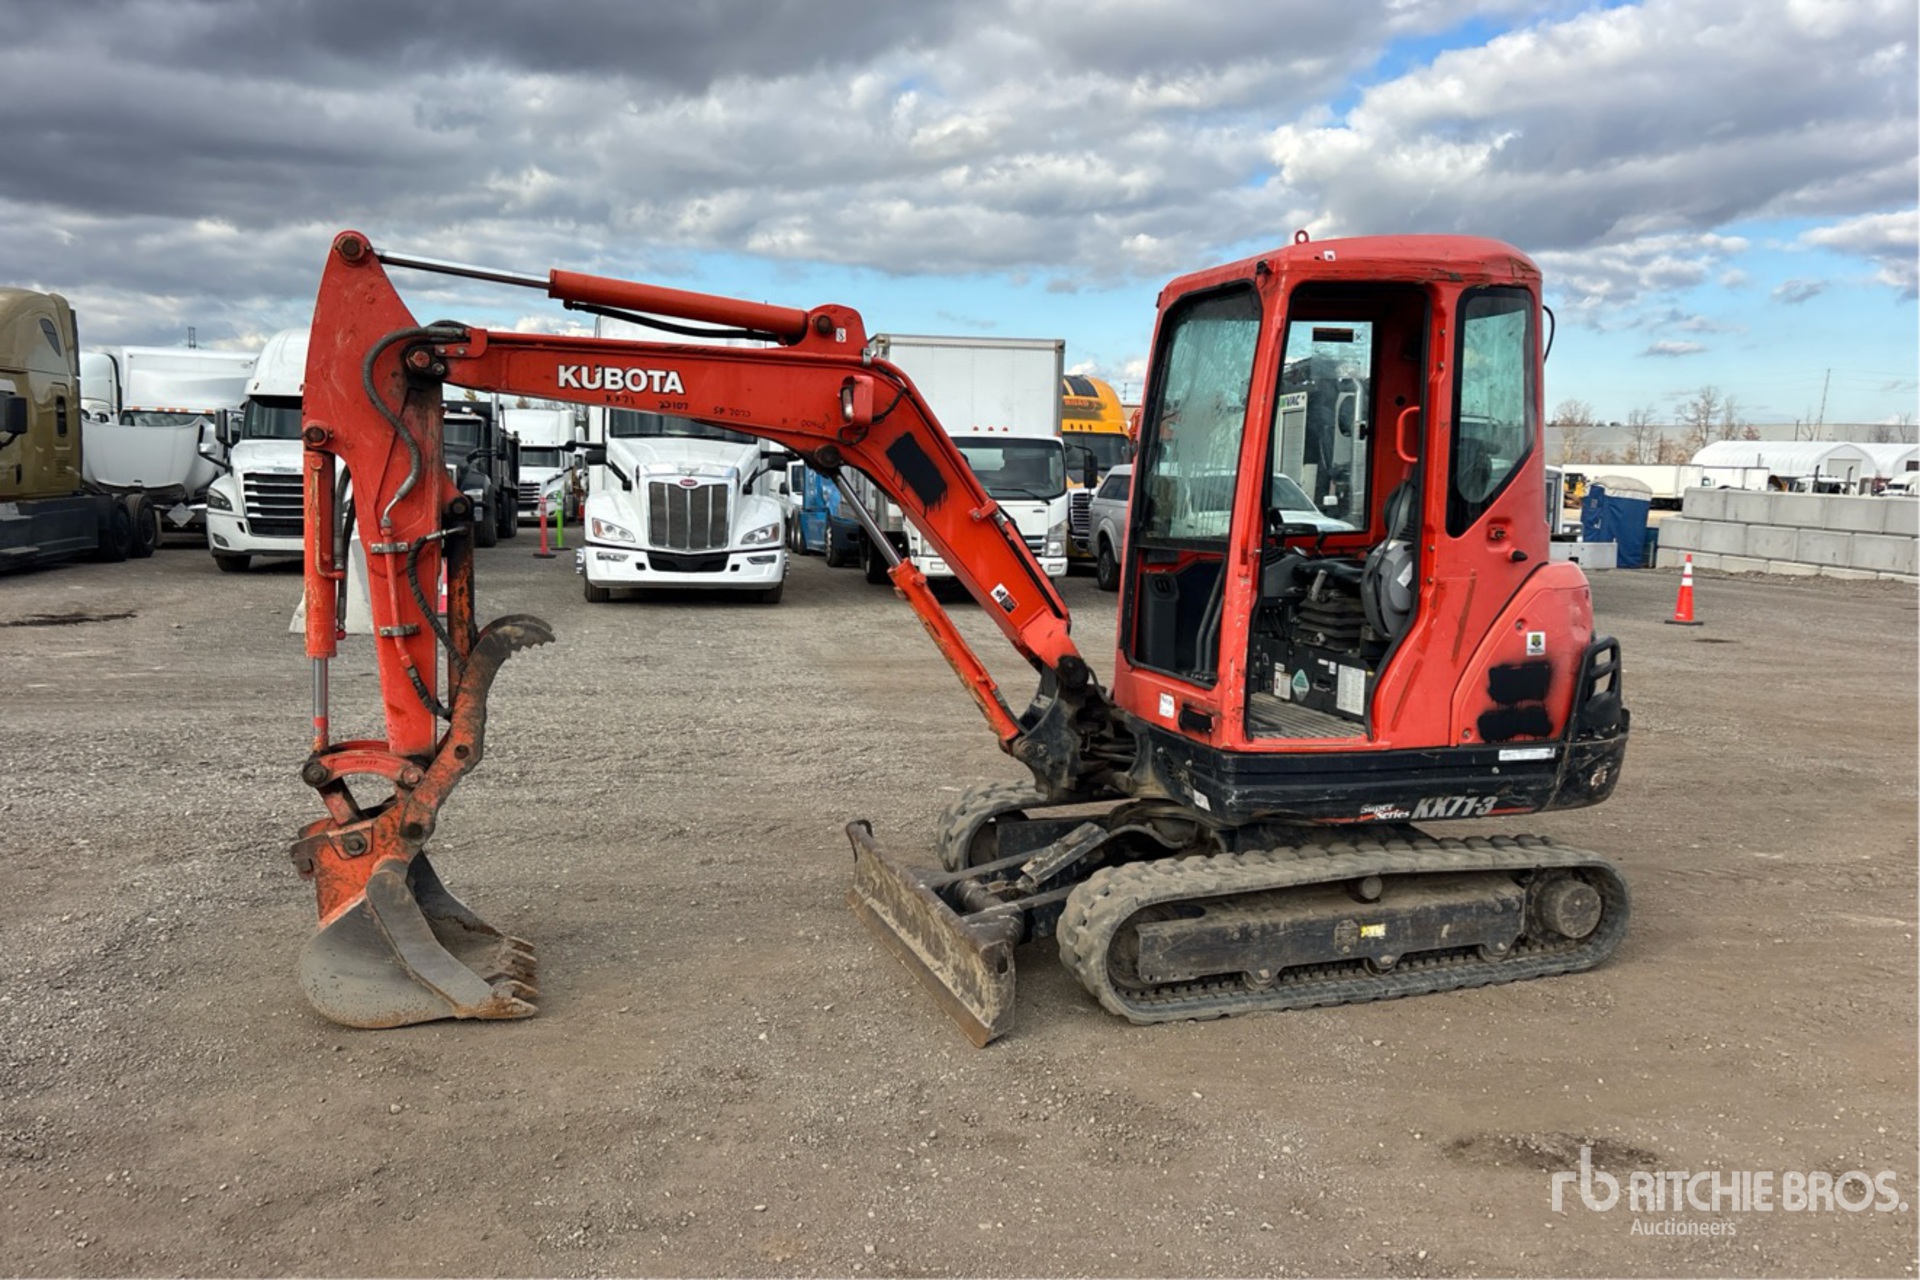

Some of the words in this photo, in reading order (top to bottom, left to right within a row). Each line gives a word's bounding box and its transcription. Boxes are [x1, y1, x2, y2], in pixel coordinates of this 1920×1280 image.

[557, 364, 686, 395] KUBOTA
[1360, 803, 1395, 814] Super
[1374, 809, 1411, 820] Series
[1410, 796, 1499, 819] KX71-3
